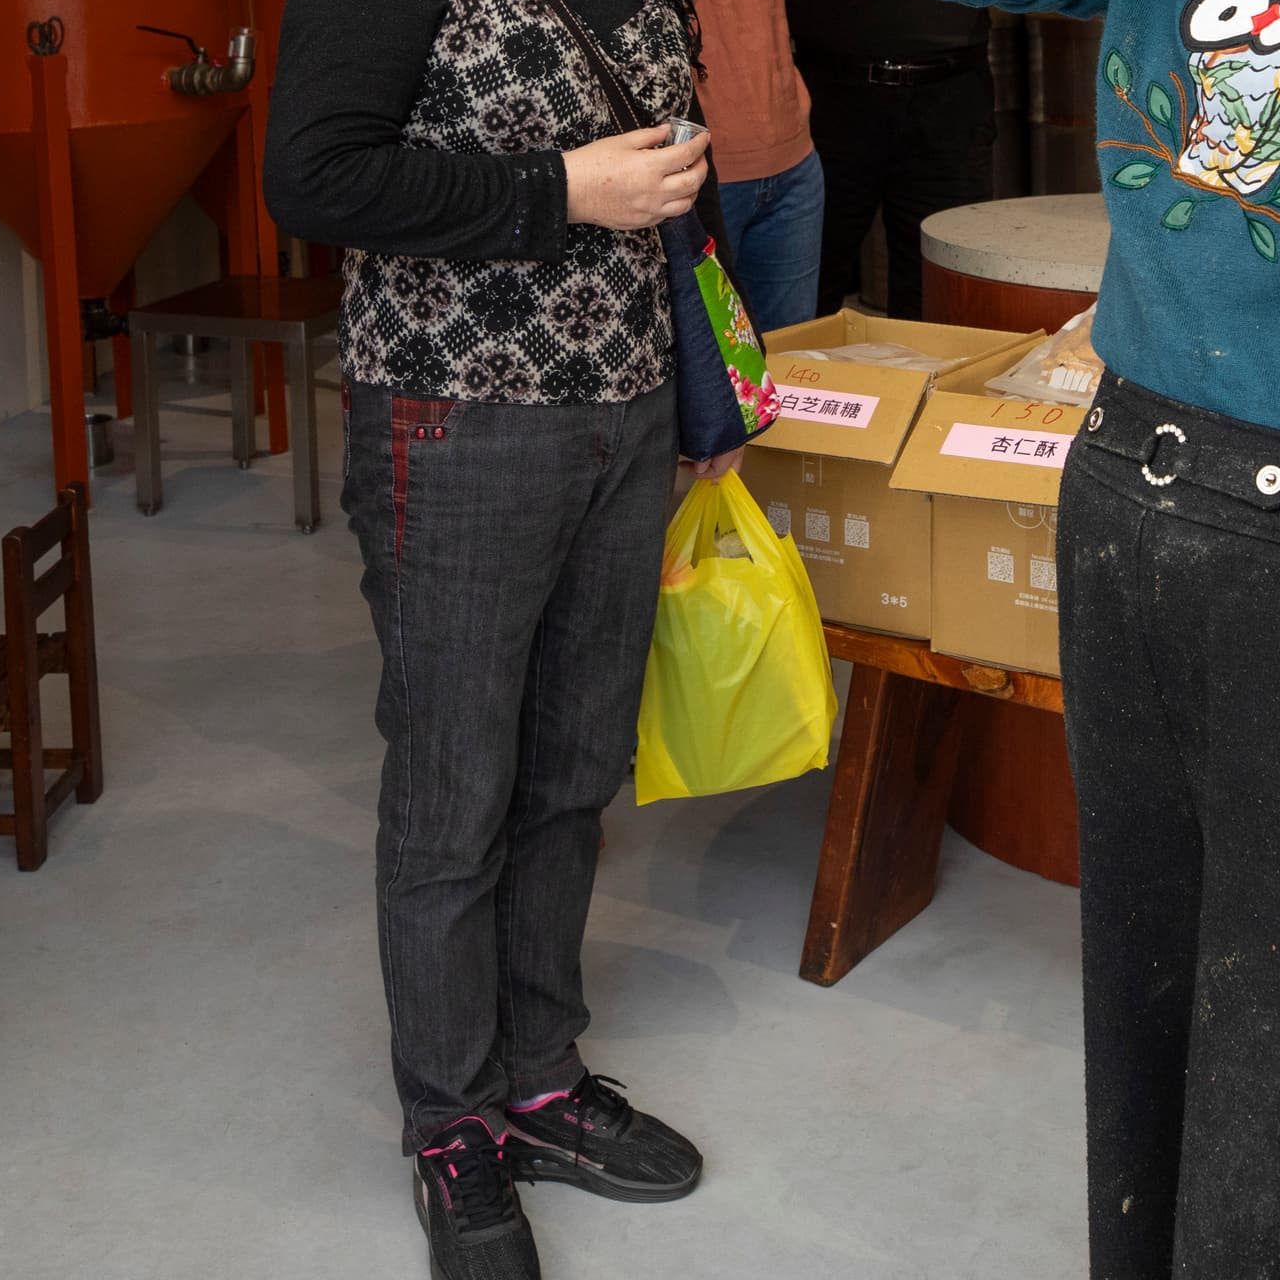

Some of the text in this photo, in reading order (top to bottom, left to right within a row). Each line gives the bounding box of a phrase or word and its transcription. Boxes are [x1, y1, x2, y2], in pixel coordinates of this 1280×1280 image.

[785, 364, 821, 384] 140
[778, 394, 863, 419] 白芝麻糖
[990, 403, 1064, 424] 150
[991, 436, 1060, 459] 杏仁酥
